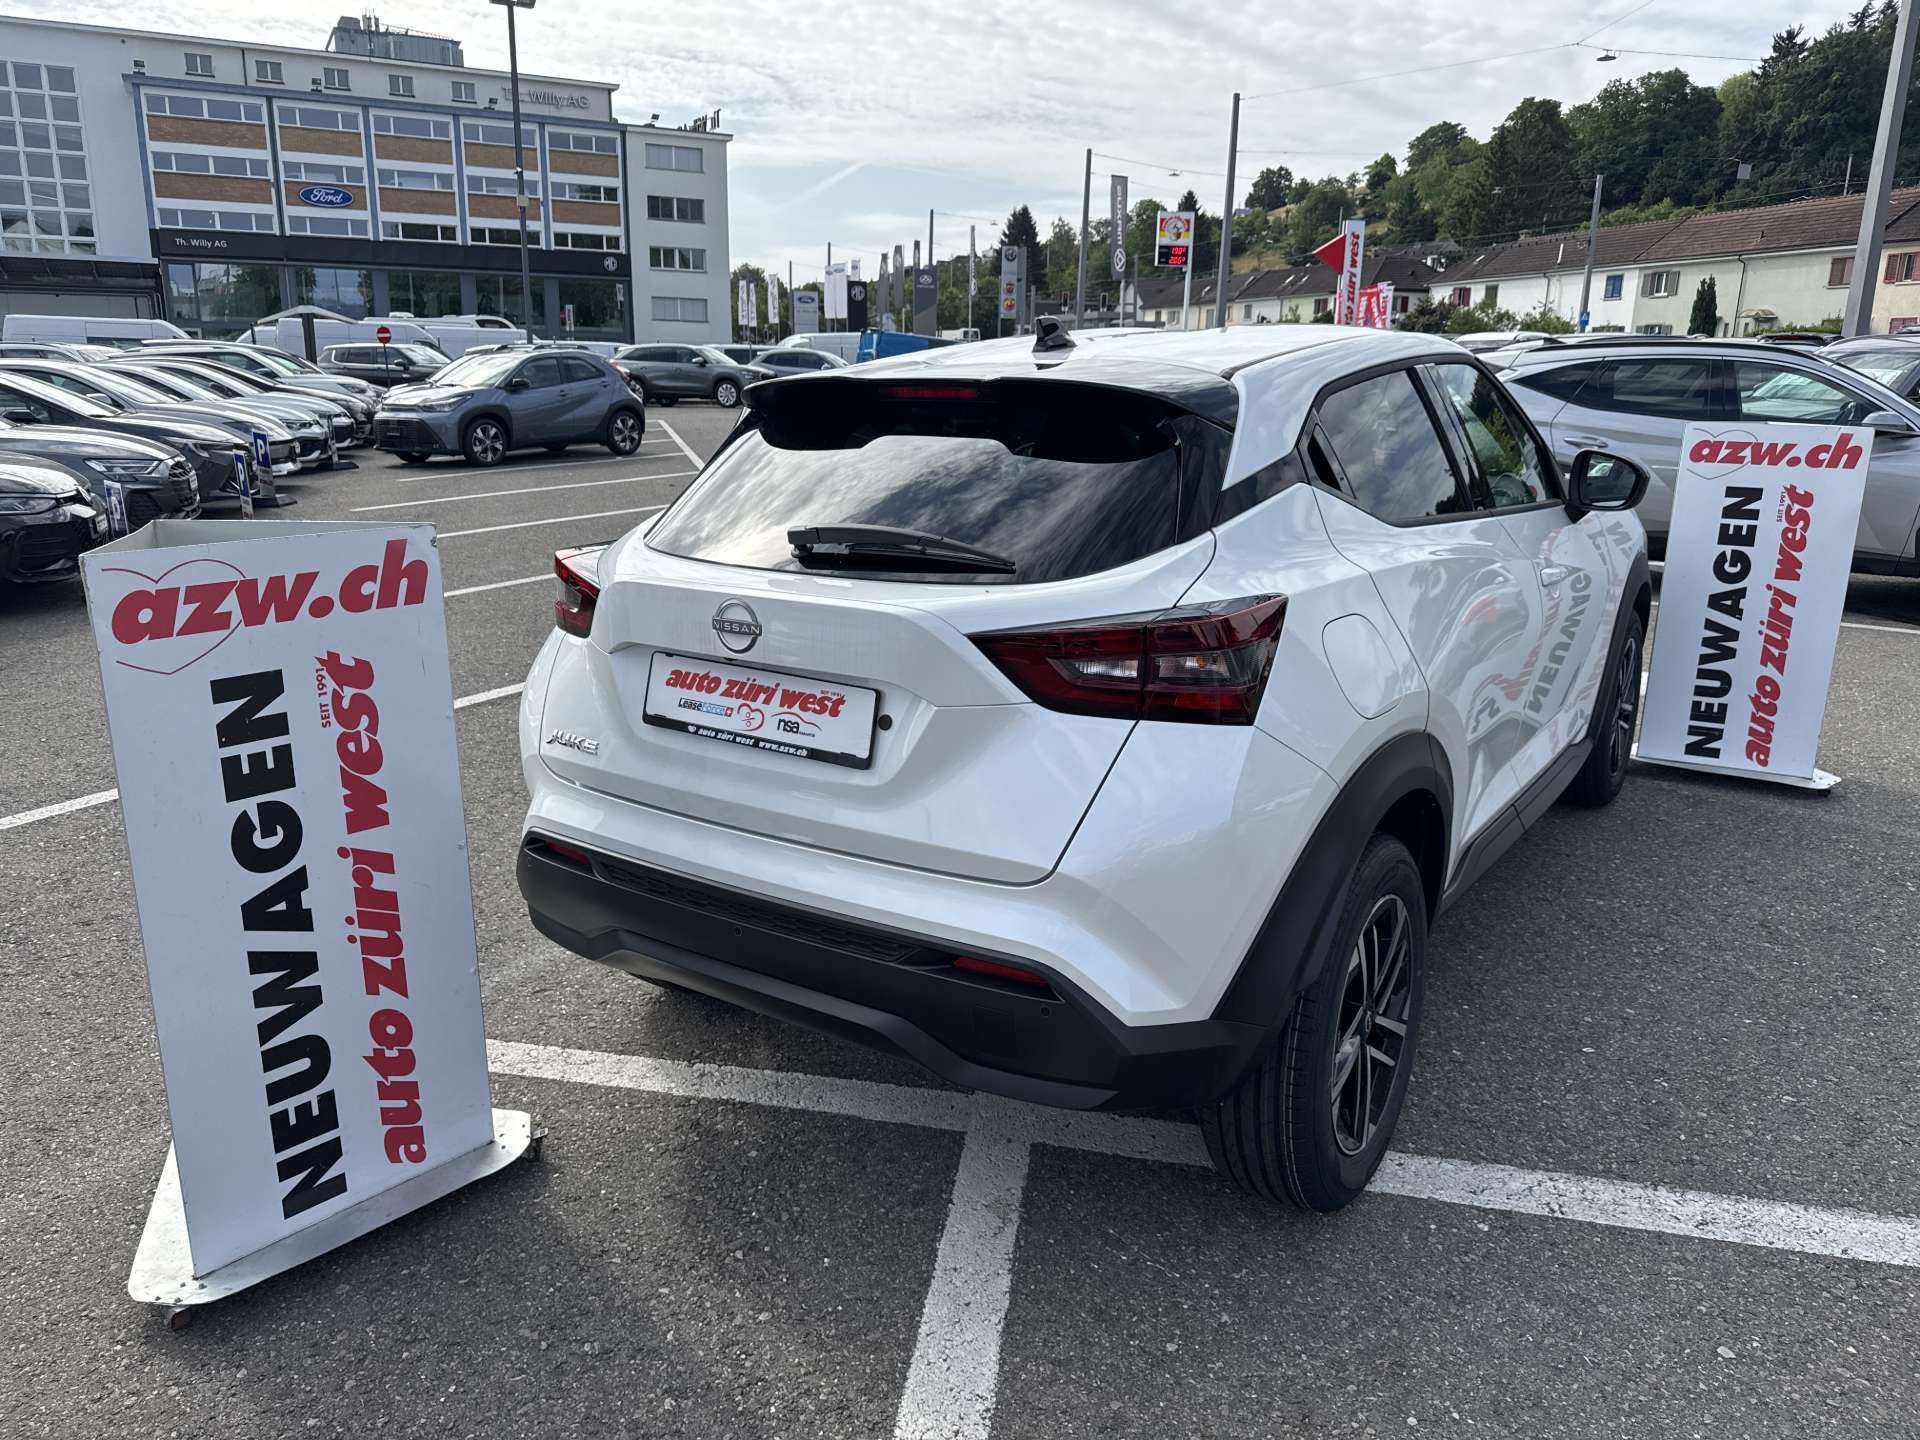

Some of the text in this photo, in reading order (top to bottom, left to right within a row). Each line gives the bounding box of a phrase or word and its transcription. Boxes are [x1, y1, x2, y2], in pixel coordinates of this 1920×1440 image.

[528, 87, 564, 109] Willy
[567, 95, 591, 109] AG
[310, 187, 343, 204] Ford
[175, 238, 227, 249] Th. Willy AG
[256, 438, 266, 463] P
[1689, 434, 1863, 470] azw.ch
[237, 462, 246, 491] P
[112, 539, 427, 644] azw.ch
[712, 618, 760, 635] NISSAN
[1684, 486, 1764, 759] NEUWAGEN
[1745, 484, 1814, 766] auto züri west
[315, 667, 332, 729] SEIT 1991
[666, 669, 846, 718] auto züri west
[697, 728, 716, 738] auto
[717, 731, 735, 742] züri
[735, 736, 755, 747] west
[777, 718, 800, 735] nsa
[545, 728, 601, 756] JUKE
[314, 650, 426, 1164] auto züri west
[209, 668, 348, 1220] NEUWAGEN
